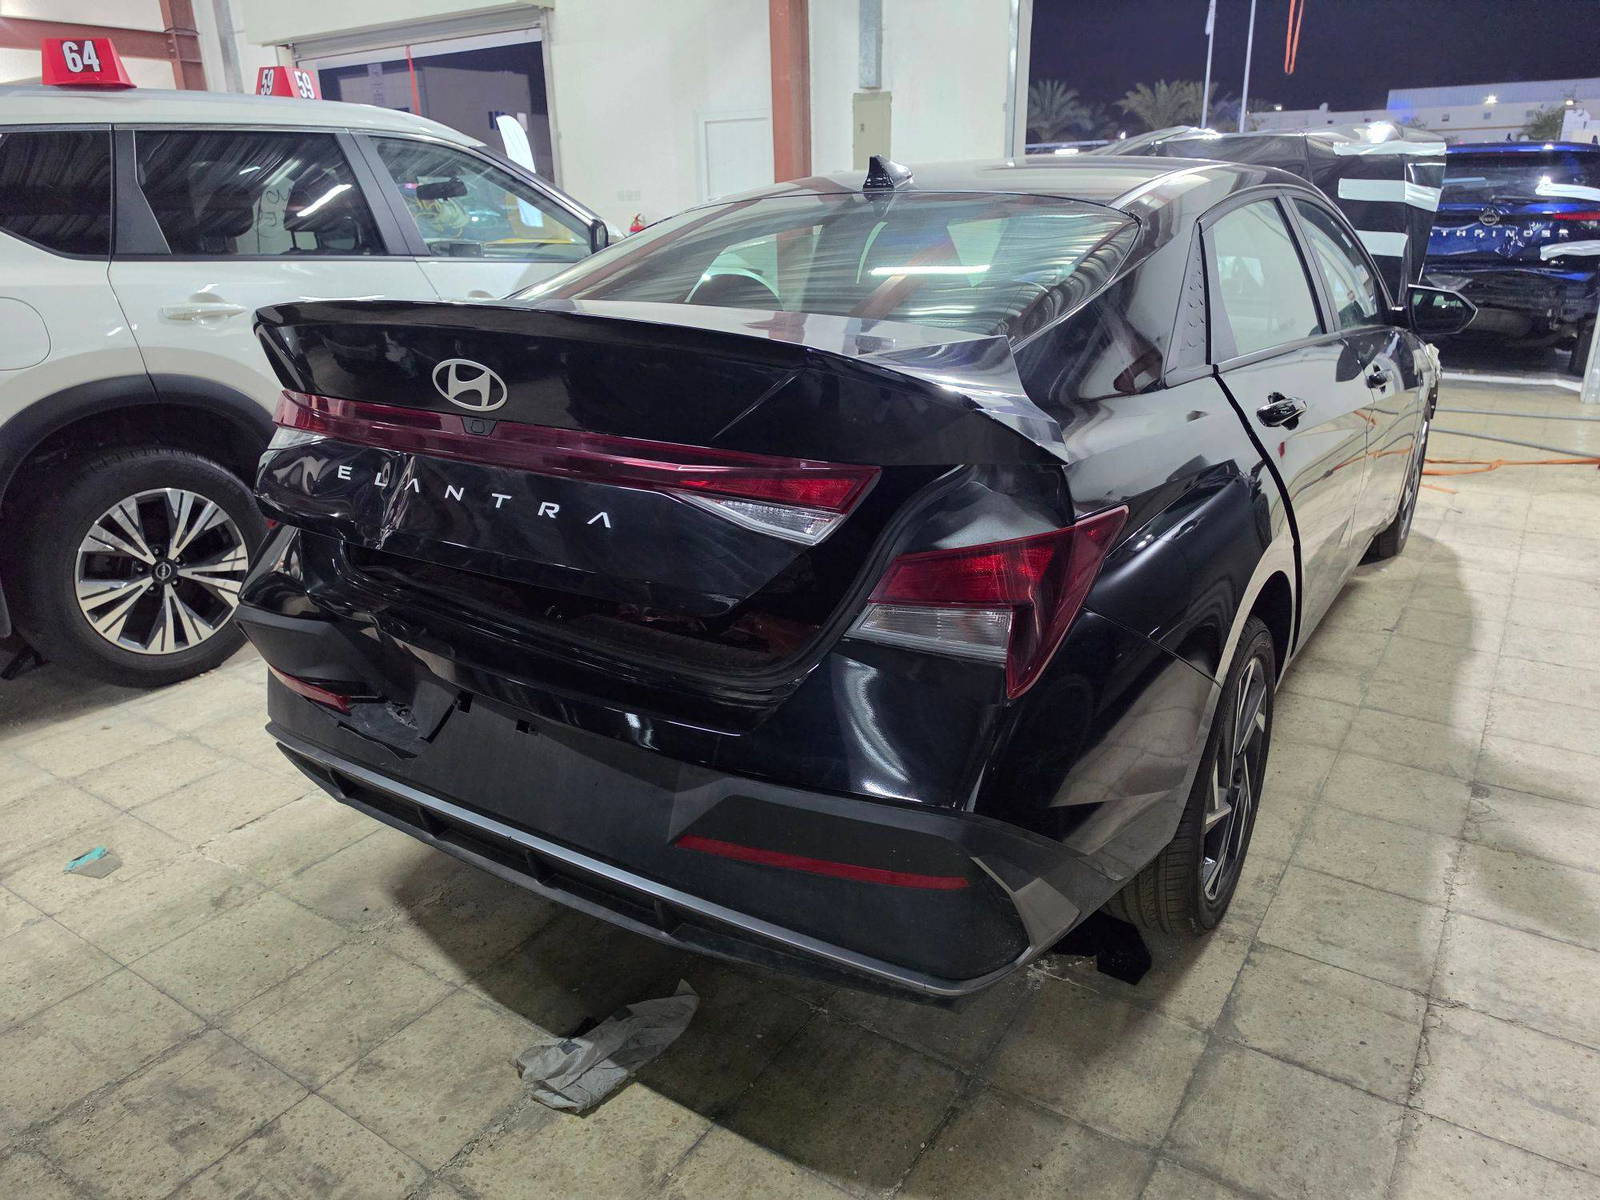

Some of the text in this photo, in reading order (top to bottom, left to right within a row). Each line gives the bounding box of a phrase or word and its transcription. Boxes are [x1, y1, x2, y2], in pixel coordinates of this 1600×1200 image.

[62, 40, 101, 73] 64
[260, 69, 274, 95] 59
[293, 71, 315, 99] 59
[337, 465, 611, 528] ELANTRA
